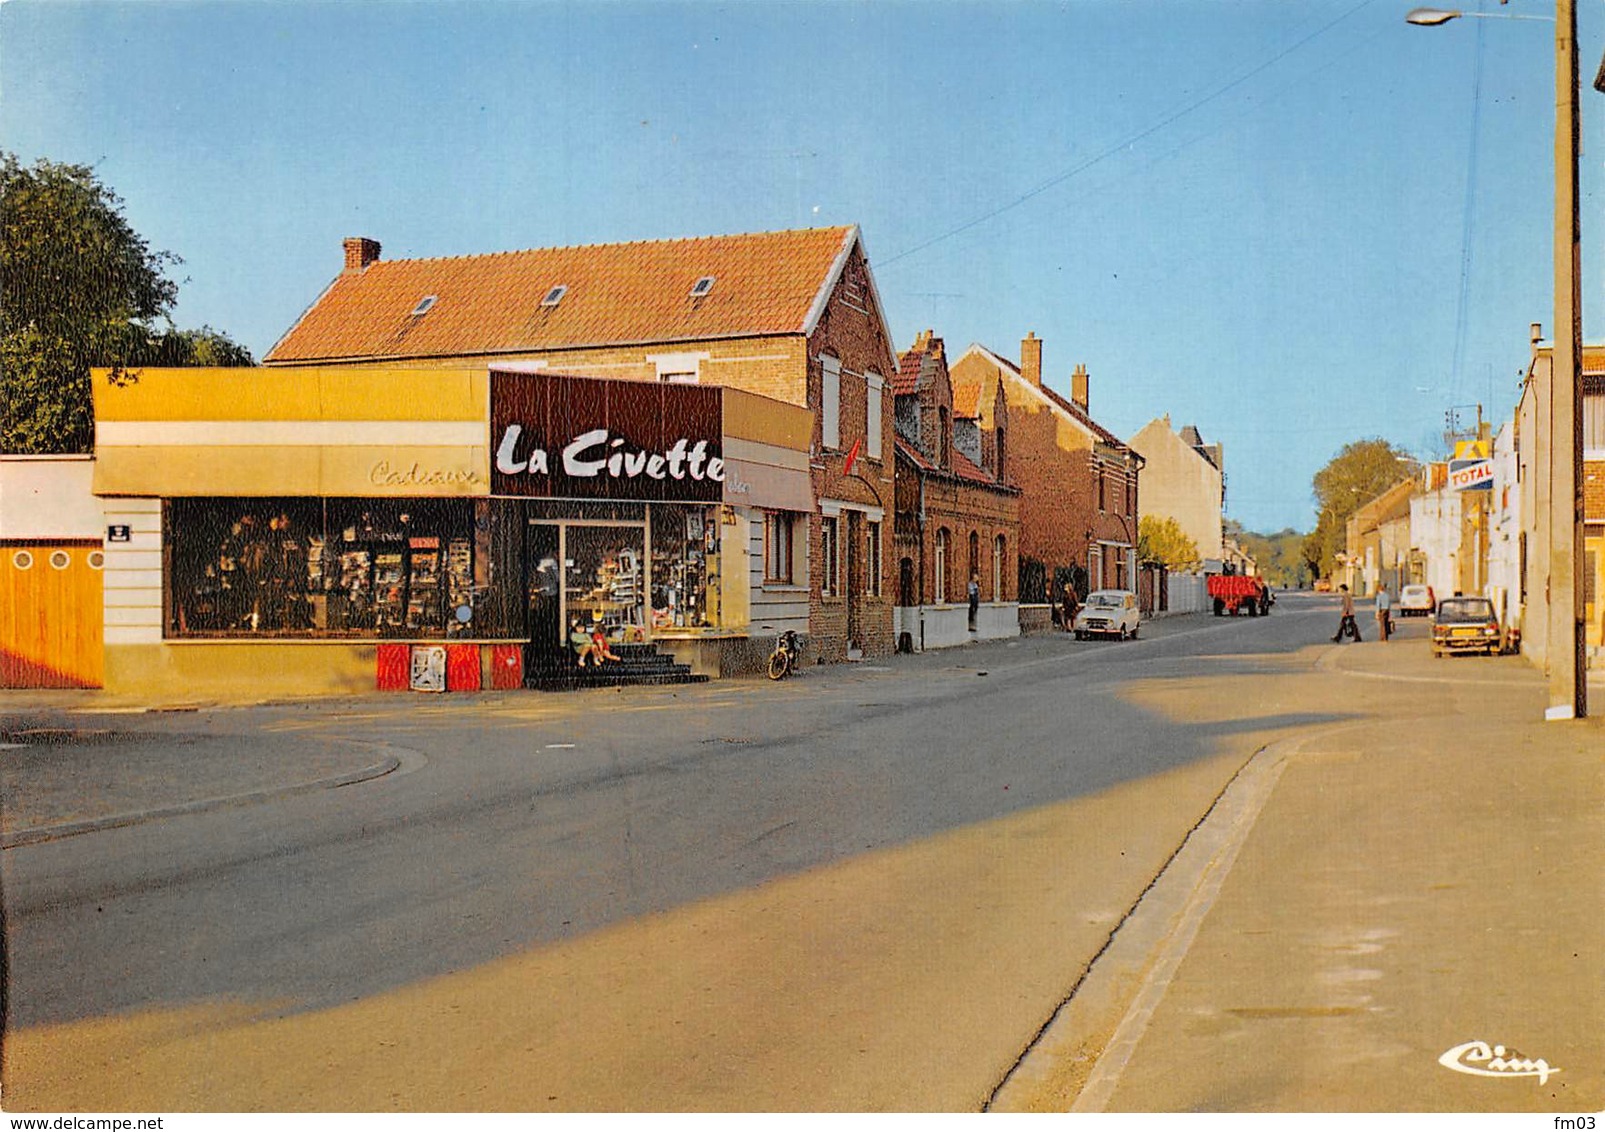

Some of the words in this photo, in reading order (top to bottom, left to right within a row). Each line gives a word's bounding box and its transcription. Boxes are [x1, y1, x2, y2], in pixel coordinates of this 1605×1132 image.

[496, 424, 549, 475] La
[562, 429, 725, 481] Civette
[371, 460, 481, 486] Cadeaux
[1452, 464, 1493, 486] TOTAL
